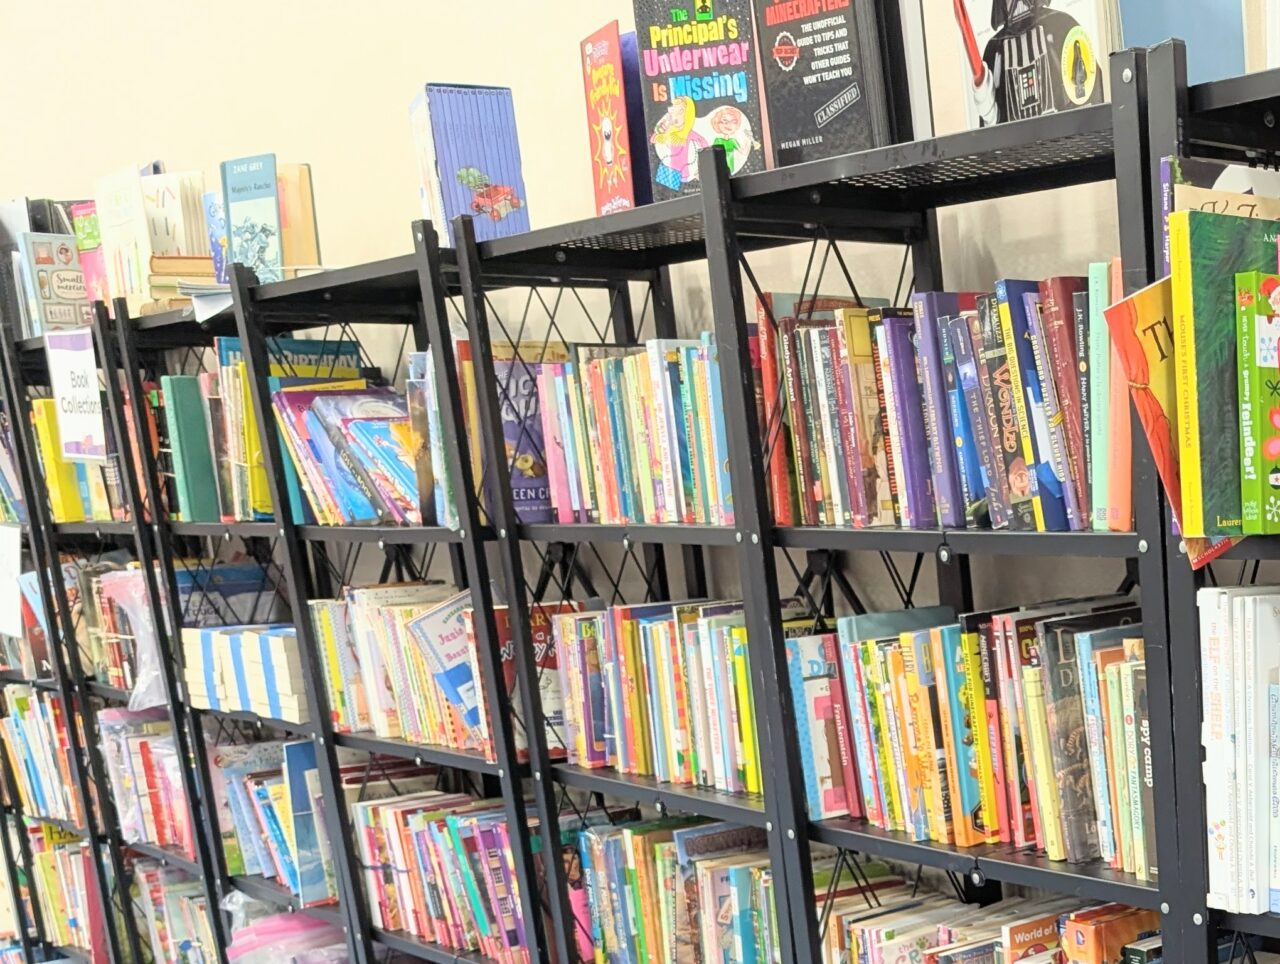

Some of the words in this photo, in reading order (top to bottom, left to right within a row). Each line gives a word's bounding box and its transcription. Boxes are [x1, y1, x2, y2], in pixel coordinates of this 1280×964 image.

[670, 7, 689, 22] The
[650, 15, 738, 48] Principal's
[800, 22, 813, 34] THE
[812, 15, 847, 31] UNOFFICIAL
[797, 35, 814, 47] GUIDE
[814, 34, 821, 44] TO
[821, 31, 835, 43] TIPS
[835, 28, 848, 41] AND
[813, 44, 834, 57] TRICKS
[834, 41, 849, 53] THAT
[643, 41, 749, 77] Underwear
[811, 59, 829, 71] OTHER
[829, 54, 851, 68] GUIDES
[803, 74, 822, 86] WON'T
[822, 70, 842, 83] TEACH
[842, 67, 853, 78] YOU
[652, 83, 668, 102] Is
[668, 71, 748, 103] Missing
[816, 86, 858, 124] CLASSIFIED
[780, 139, 800, 150] MEGAN
[801, 135, 824, 148] MILLER
[233, 162, 248, 174] ZANE
[249, 161, 263, 172] GREY
[56, 272, 85, 284] Small
[70, 371, 90, 389] Book
[833, 703, 849, 766] Frankenstein
[1140, 719, 1150, 747] spy
[1143, 748, 1154, 788] camp
[1014, 929, 1042, 945] World
[1043, 927, 1053, 937] of
